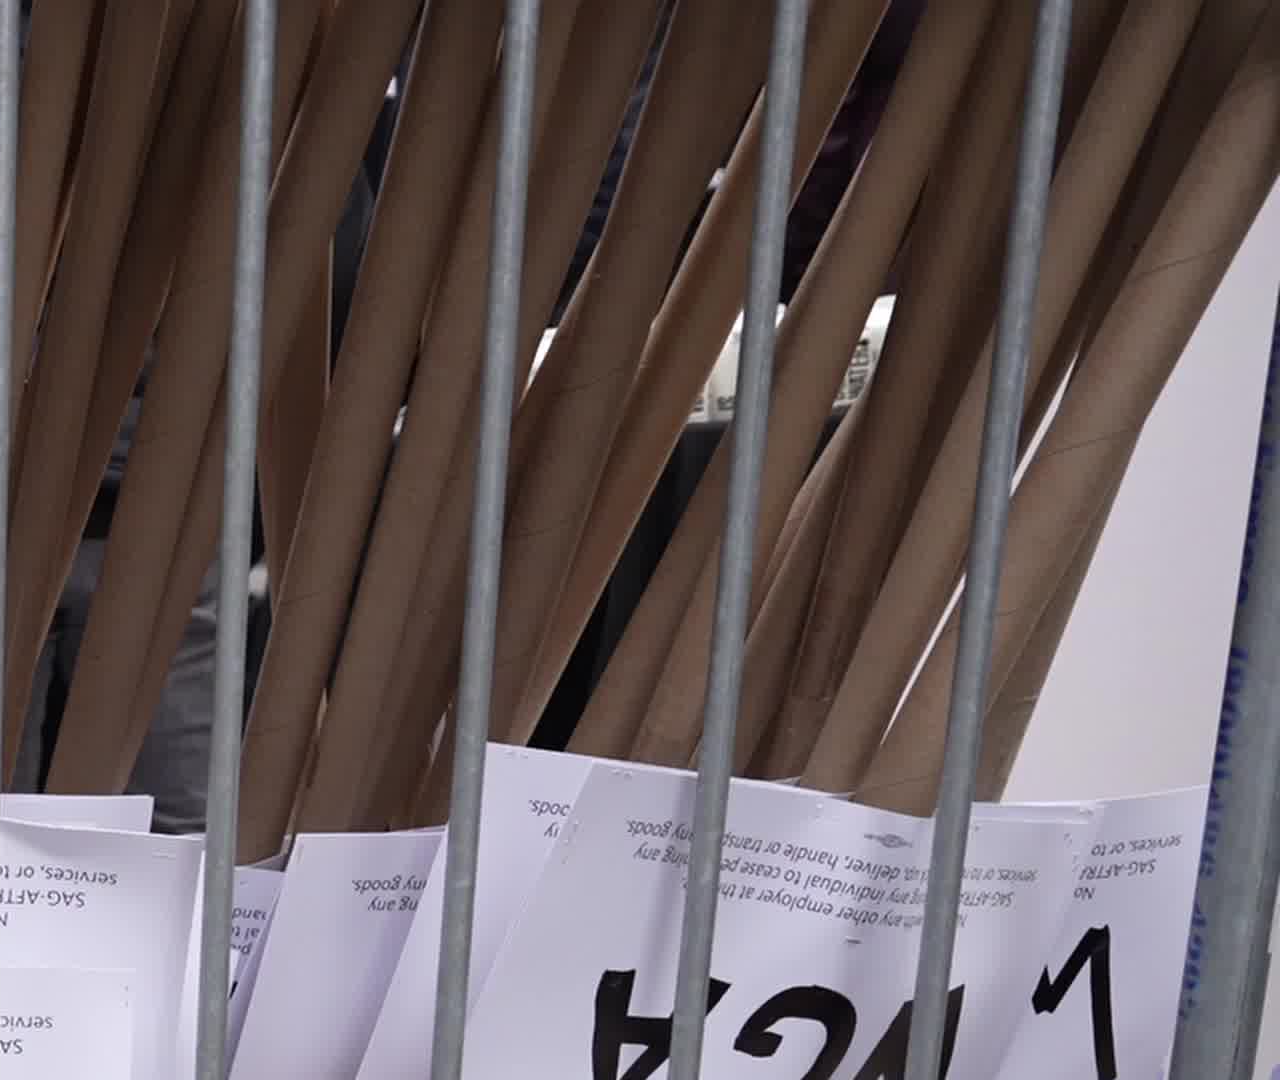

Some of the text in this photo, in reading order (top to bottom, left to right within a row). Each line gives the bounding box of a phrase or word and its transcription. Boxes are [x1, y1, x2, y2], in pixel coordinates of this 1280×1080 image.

[528, 799, 569, 817] oods.
[626, 819, 672, 839] goods.
[633, 842, 660, 864] any
[765, 841, 781, 857] or
[783, 843, 838, 870] handle
[1091, 843, 1106, 857] to
[1109, 842, 1125, 856] or
[15, 867, 34, 878] or
[40, 865, 117, 886] services,
[742, 861, 780, 880] cease
[784, 869, 801, 887] to
[844, 856, 900, 883] deliver,
[1078, 860, 1156, 881] SAG-AFTR
[352, 874, 426, 895] ny goods.
[739, 885, 755, 897] at
[806, 874, 885, 905] individual
[1074, 887, 1095, 900] No
[368, 896, 395, 913] any
[757, 888, 832, 916] employer
[837, 907, 878, 925] other
